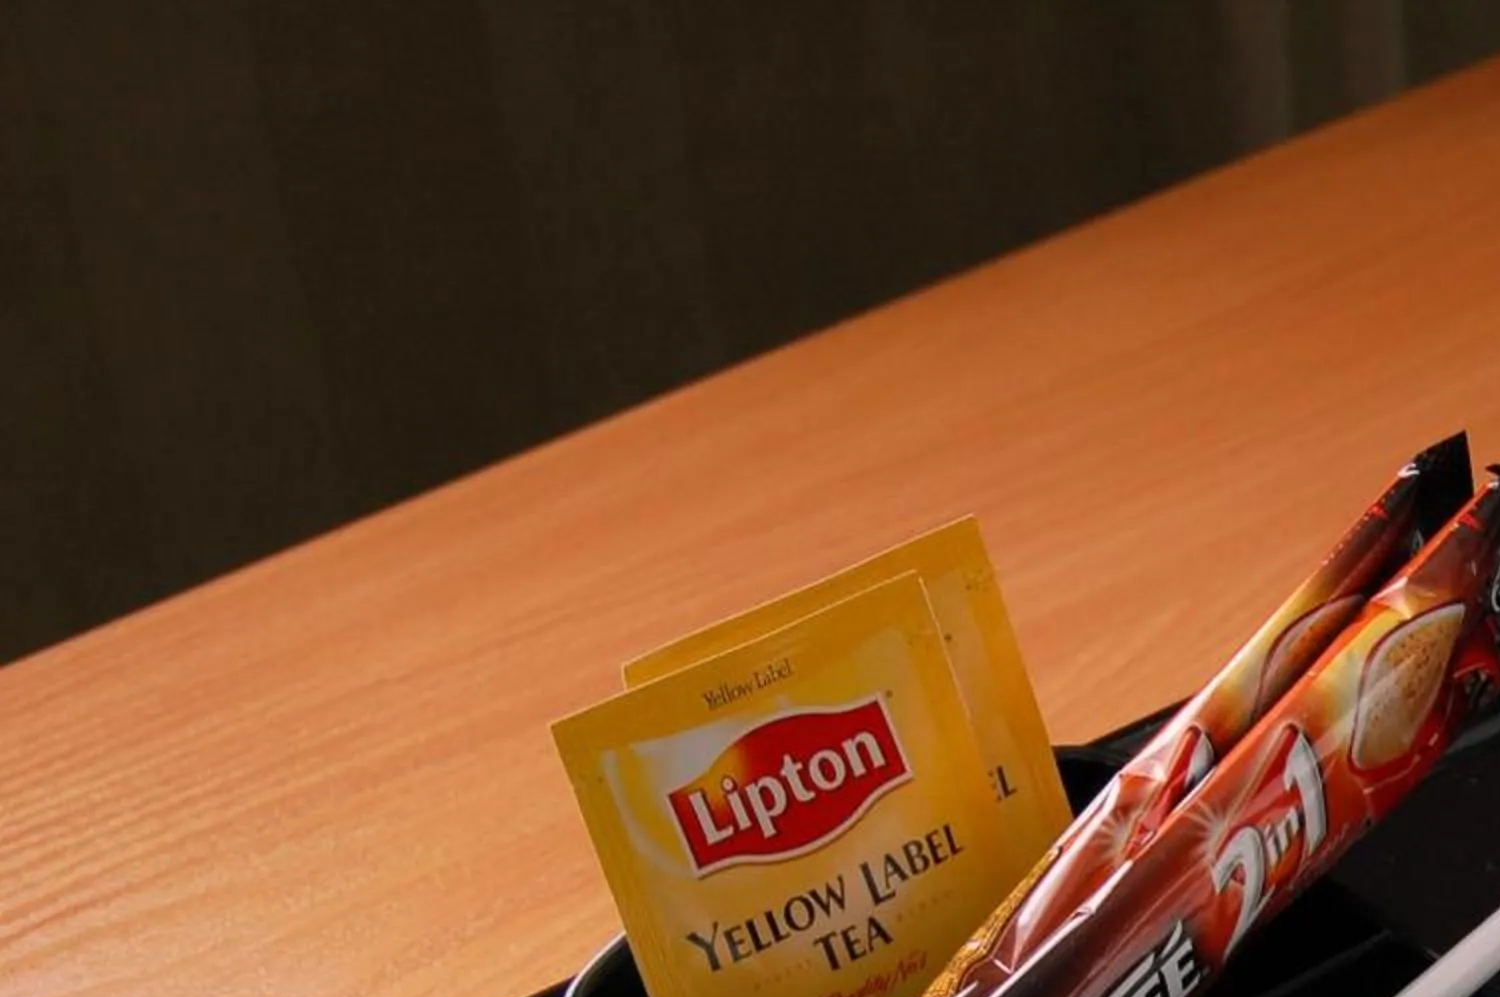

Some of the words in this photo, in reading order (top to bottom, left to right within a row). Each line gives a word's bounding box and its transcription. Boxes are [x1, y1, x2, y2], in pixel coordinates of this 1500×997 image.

[687, 726, 887, 846] Lipton
[686, 874, 847, 973] YELLOW
[859, 823, 965, 907] LABEL
[812, 916, 894, 972] TEA
